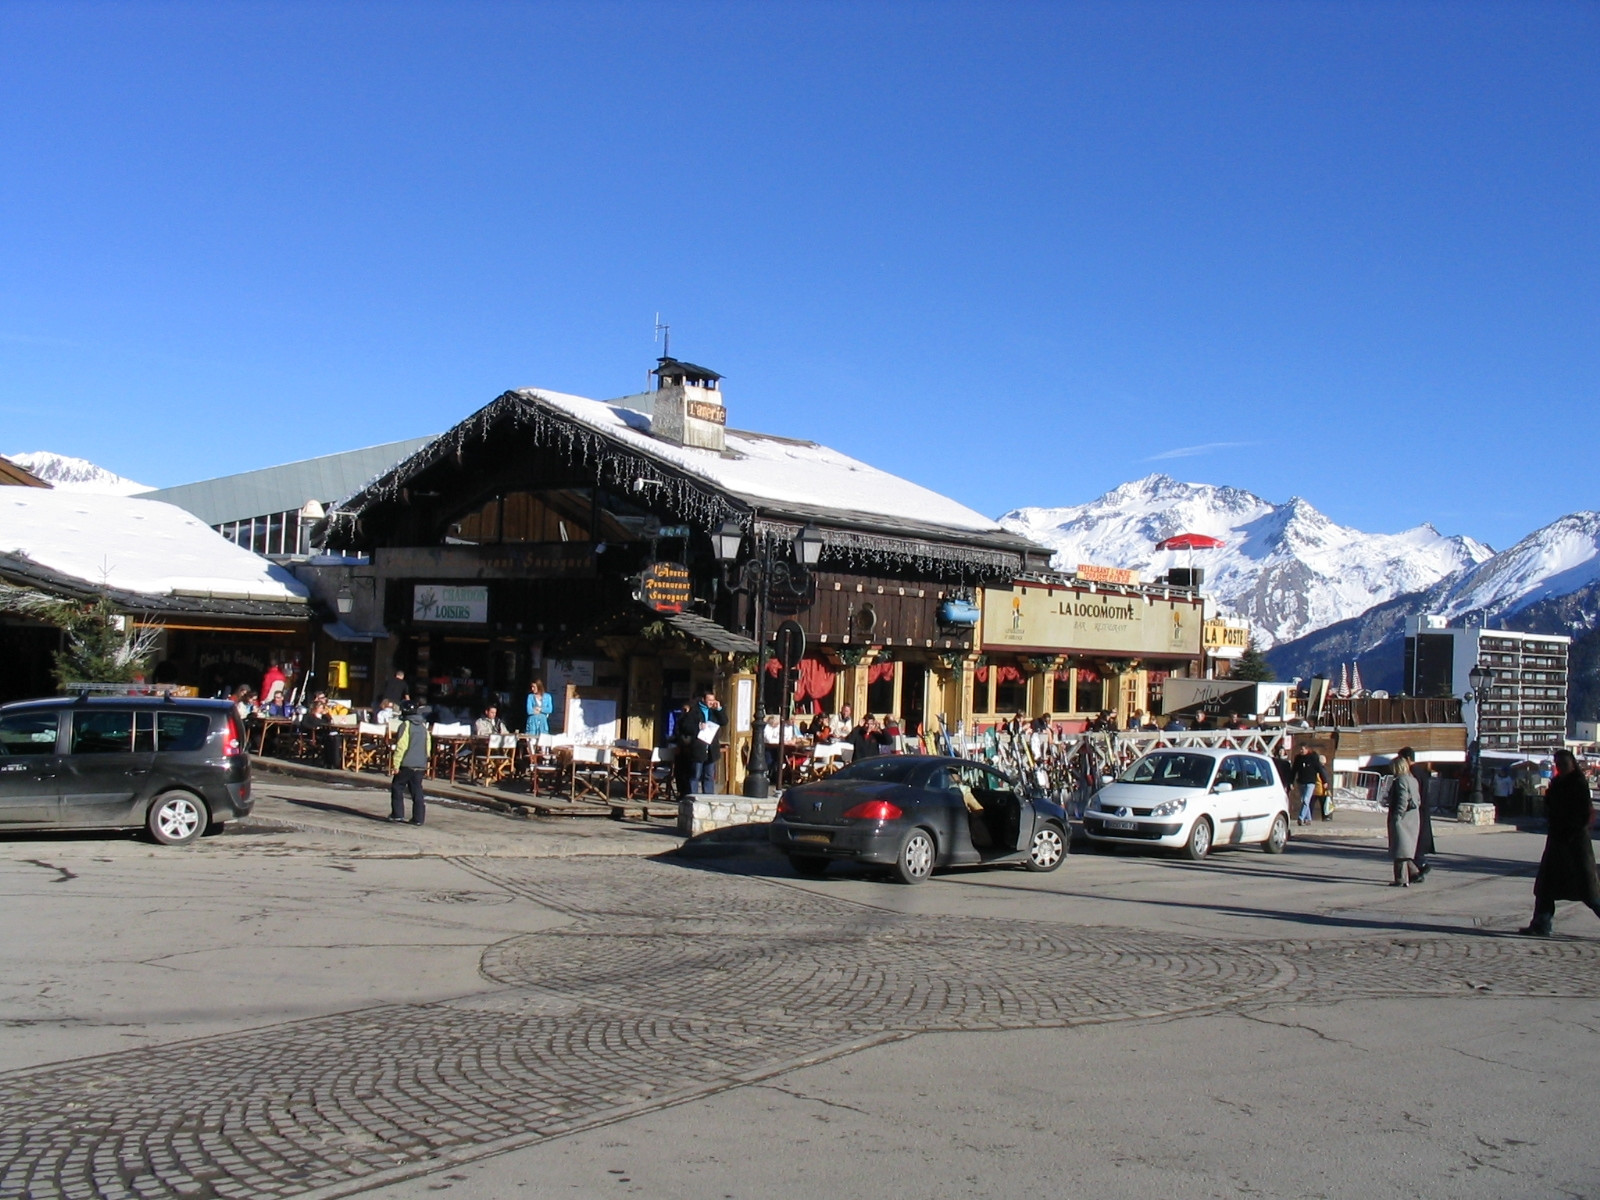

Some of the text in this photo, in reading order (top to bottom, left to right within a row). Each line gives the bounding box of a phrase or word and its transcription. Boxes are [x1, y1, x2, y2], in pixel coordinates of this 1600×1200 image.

[645, 578, 691, 590] Restaurant
[442, 588, 486, 602] CHARDON
[648, 590, 689, 602] Savoyard
[435, 604, 470, 619] LOISIRS
[1059, 602, 1134, 621] LA LOCOMOTIVE
[1204, 627, 1244, 645] LA POSTE
